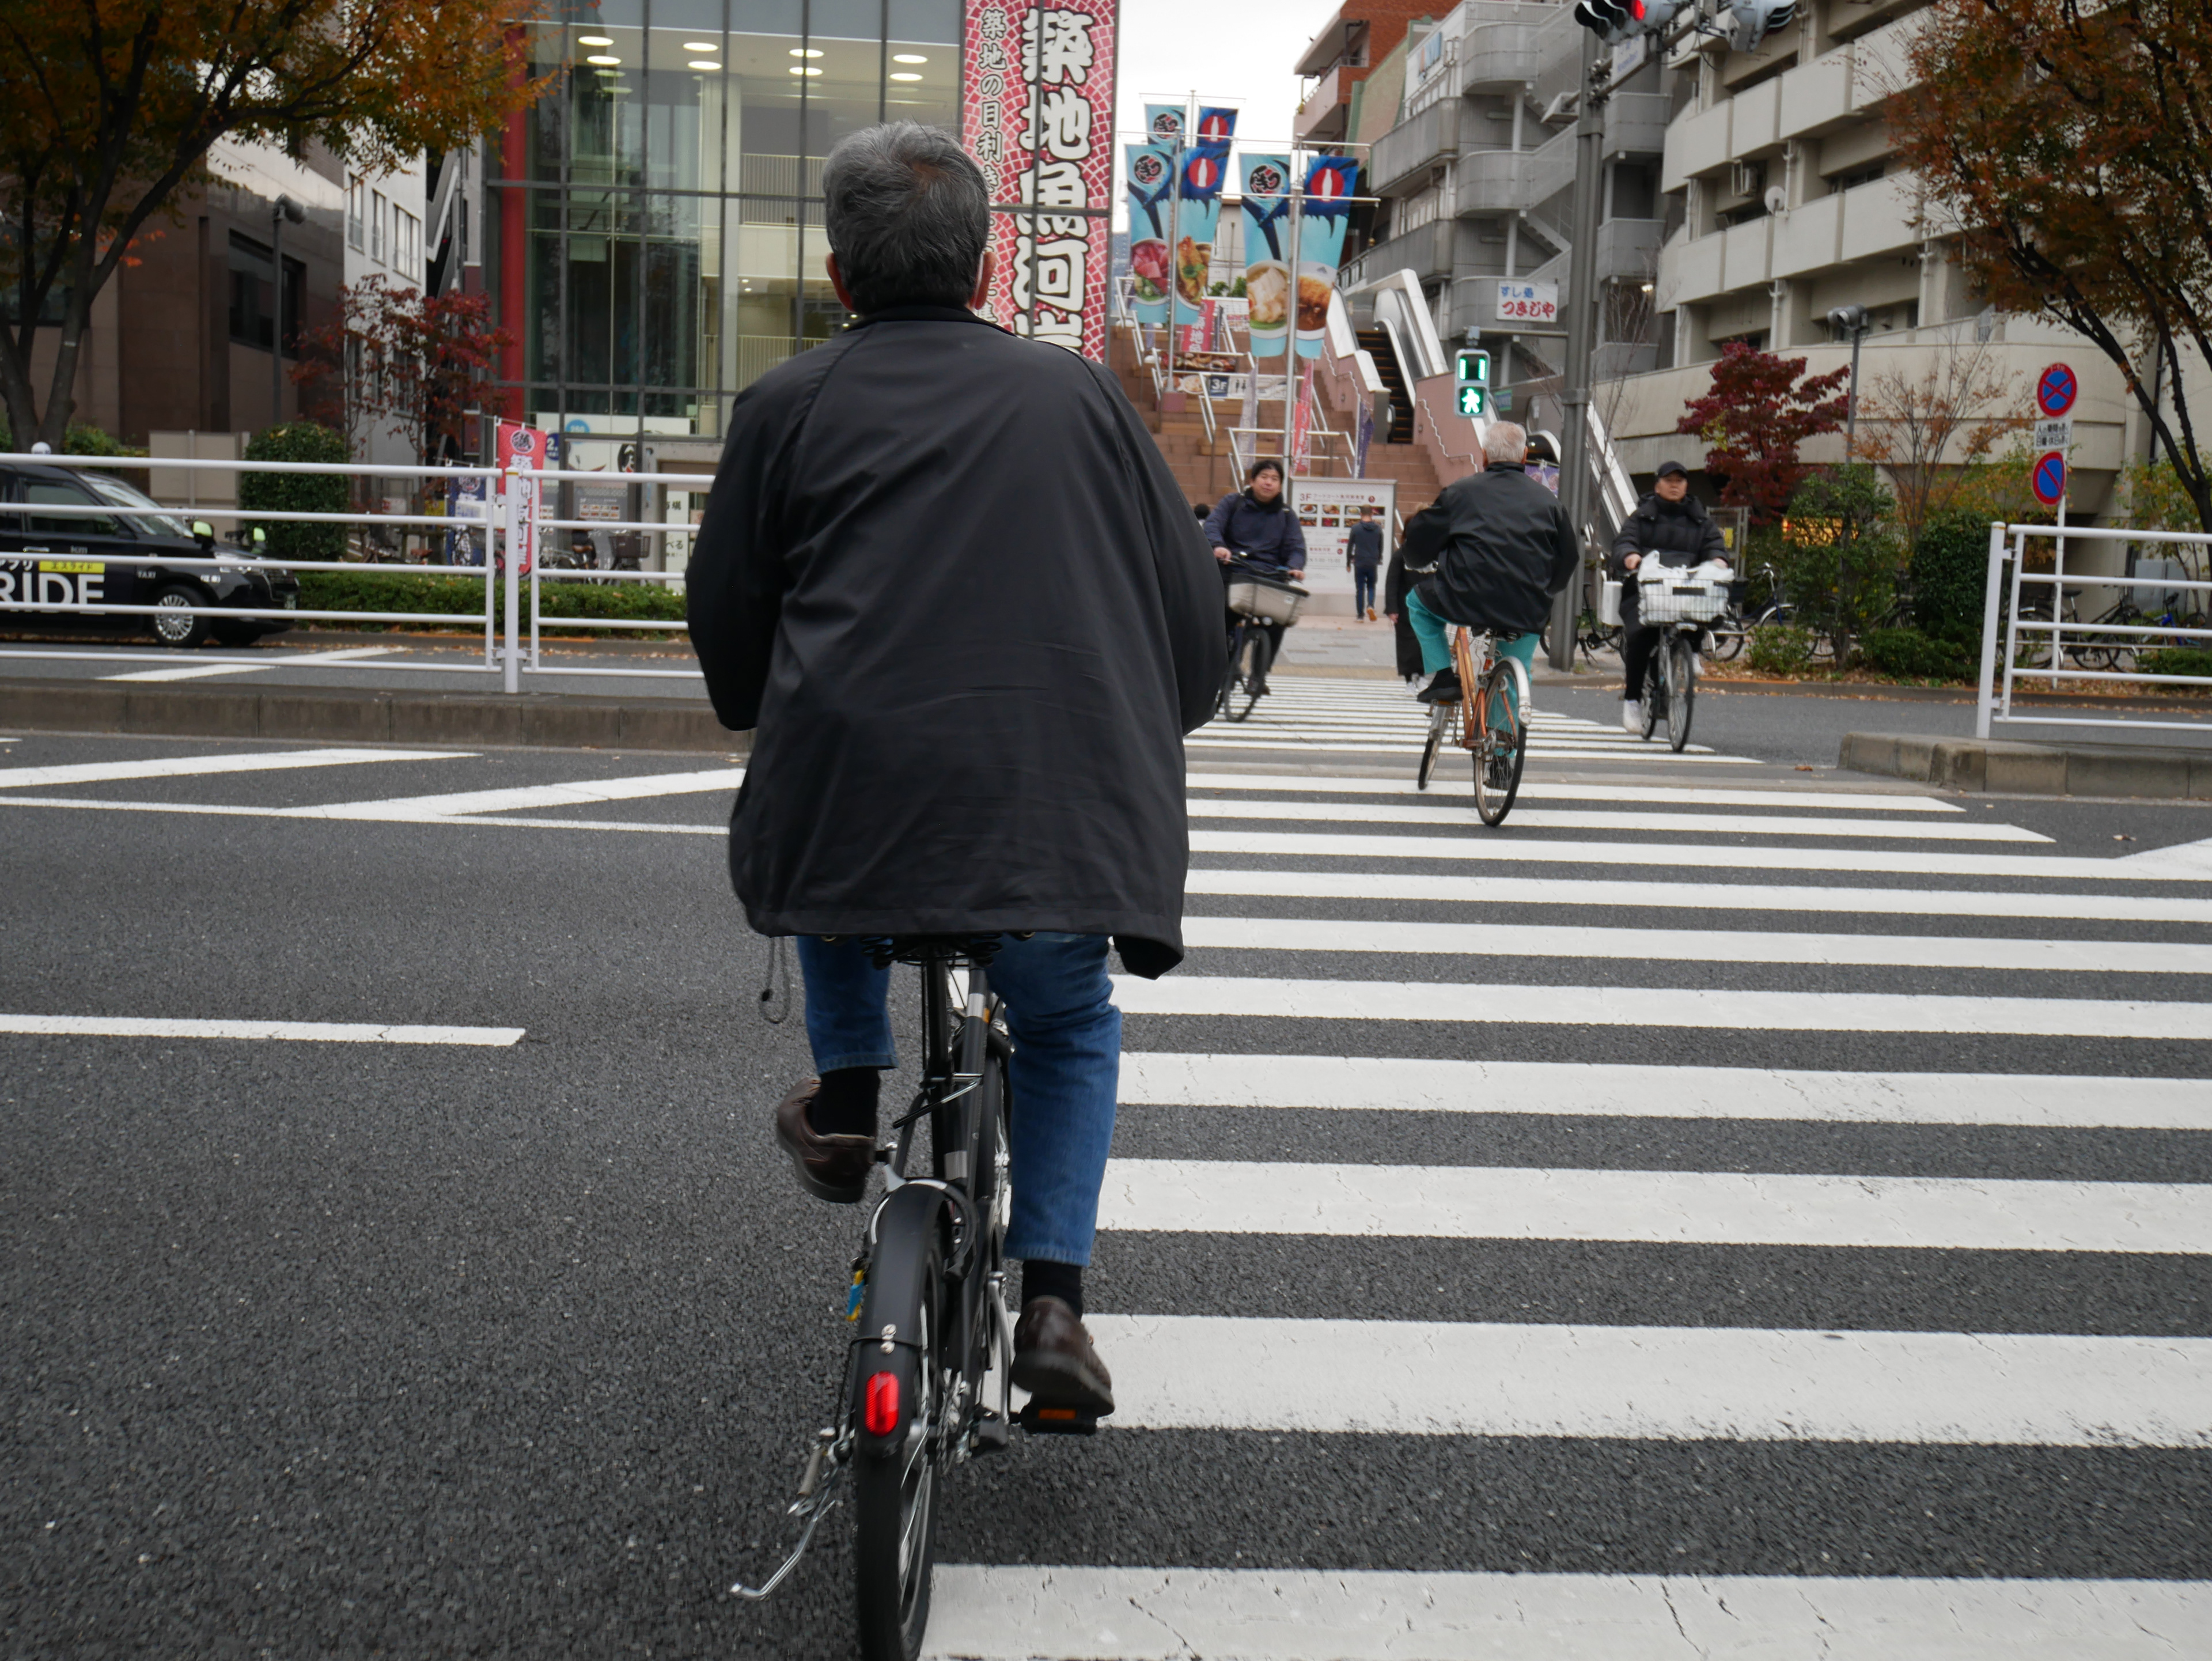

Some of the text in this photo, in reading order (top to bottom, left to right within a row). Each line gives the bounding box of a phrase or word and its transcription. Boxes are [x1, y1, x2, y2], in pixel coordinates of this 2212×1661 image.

[1502, 300, 1555, 318] つきじや
[1211, 379, 1228, 391] 3F
[1300, 493, 1312, 502] 3F
